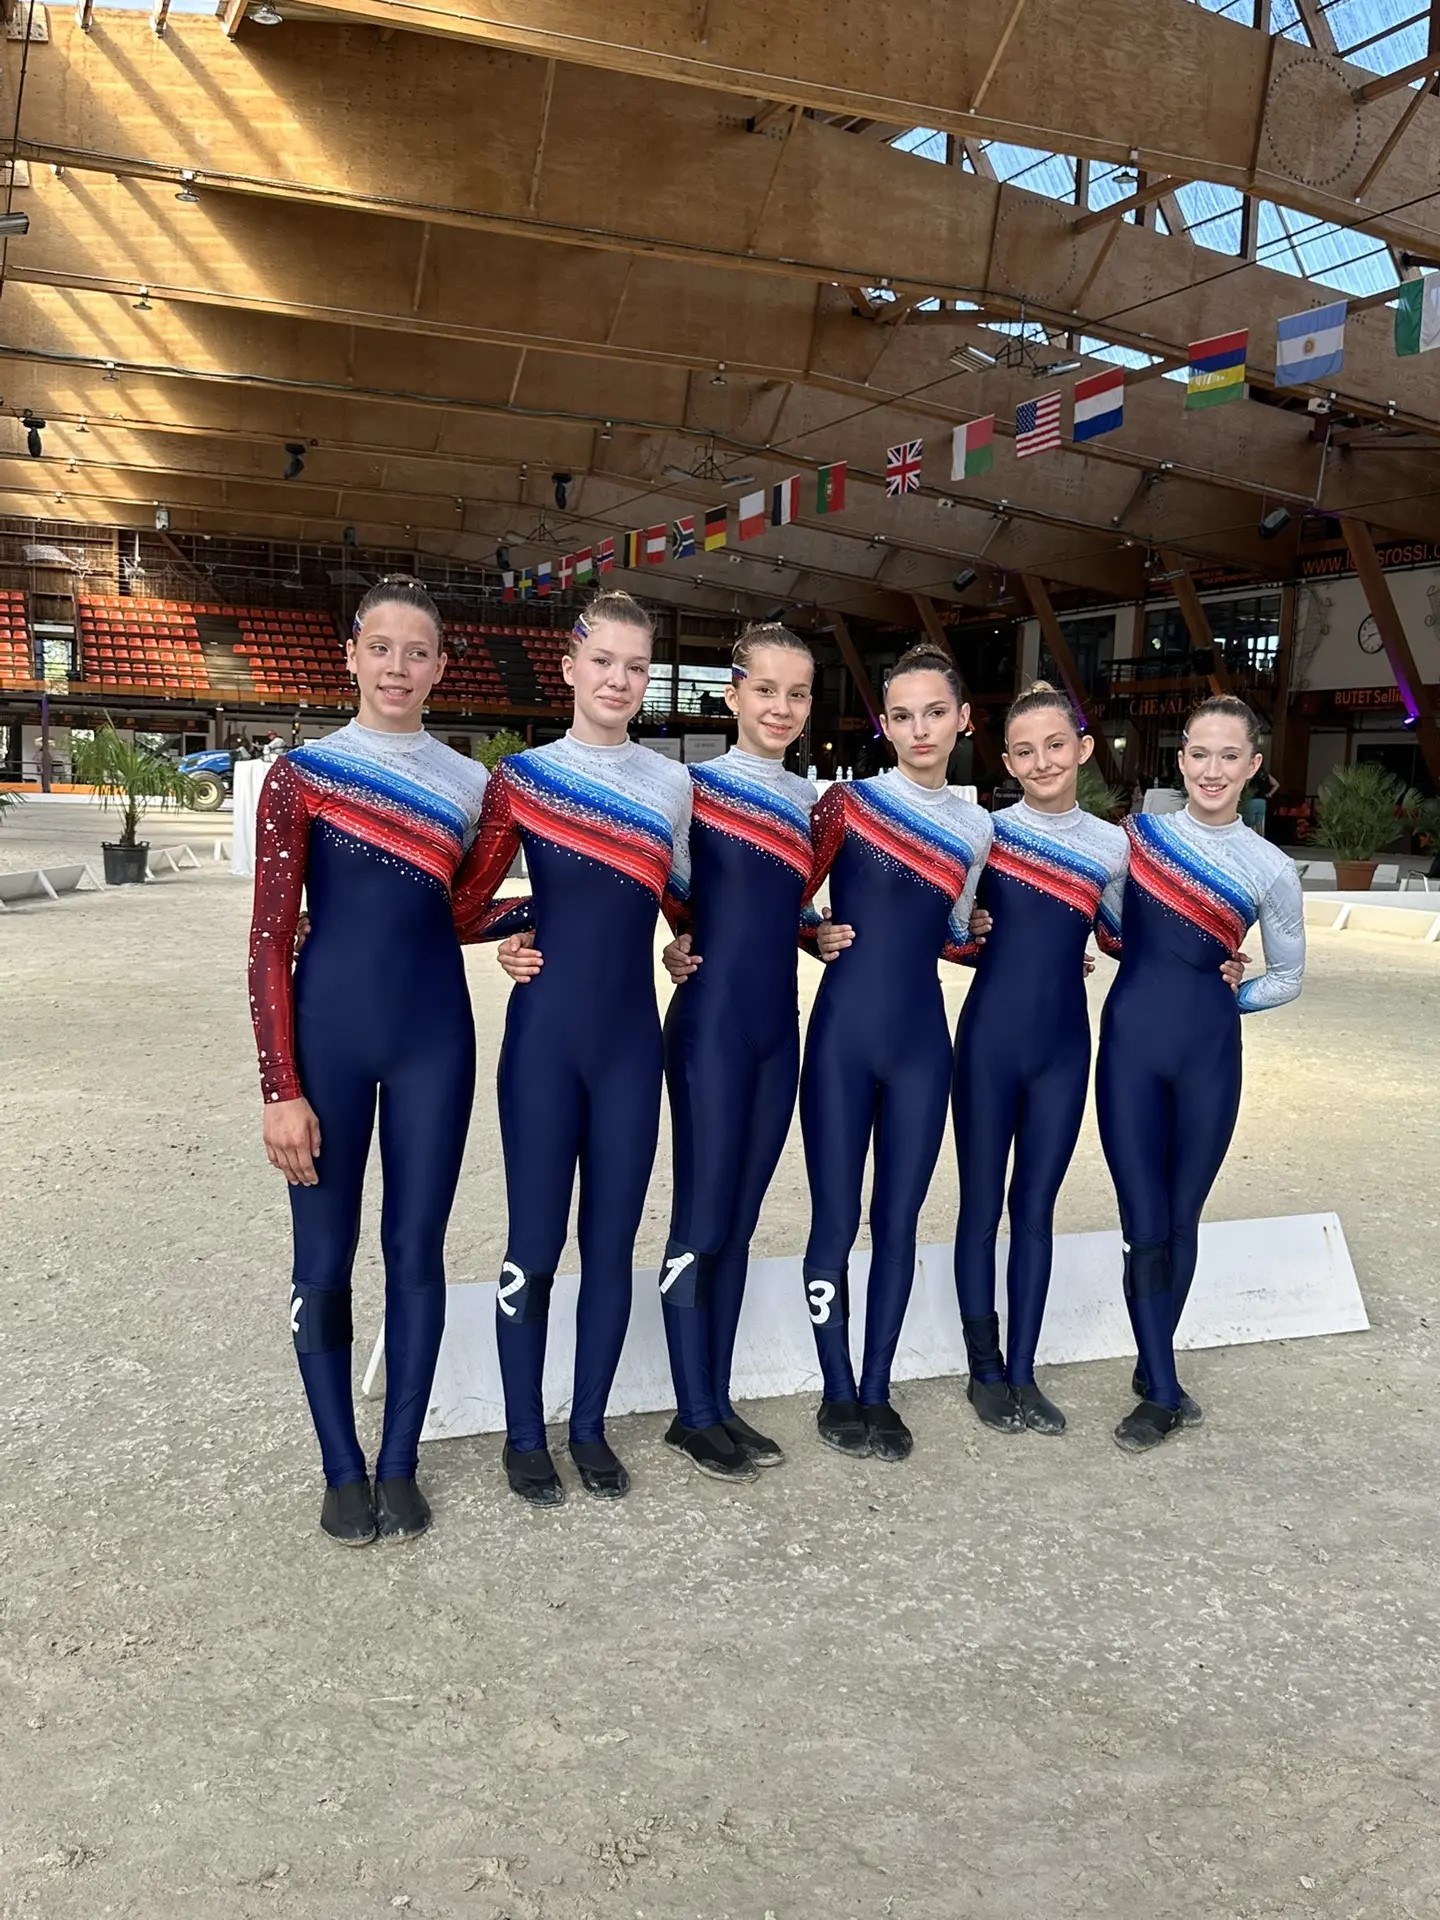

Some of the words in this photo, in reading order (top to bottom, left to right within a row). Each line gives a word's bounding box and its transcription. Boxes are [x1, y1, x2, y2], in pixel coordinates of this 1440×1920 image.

[1335, 690, 1372, 705] BUTET
[497, 1261, 526, 1316] 2
[659, 1252, 695, 1294] 1
[808, 1279, 836, 1324] 3
